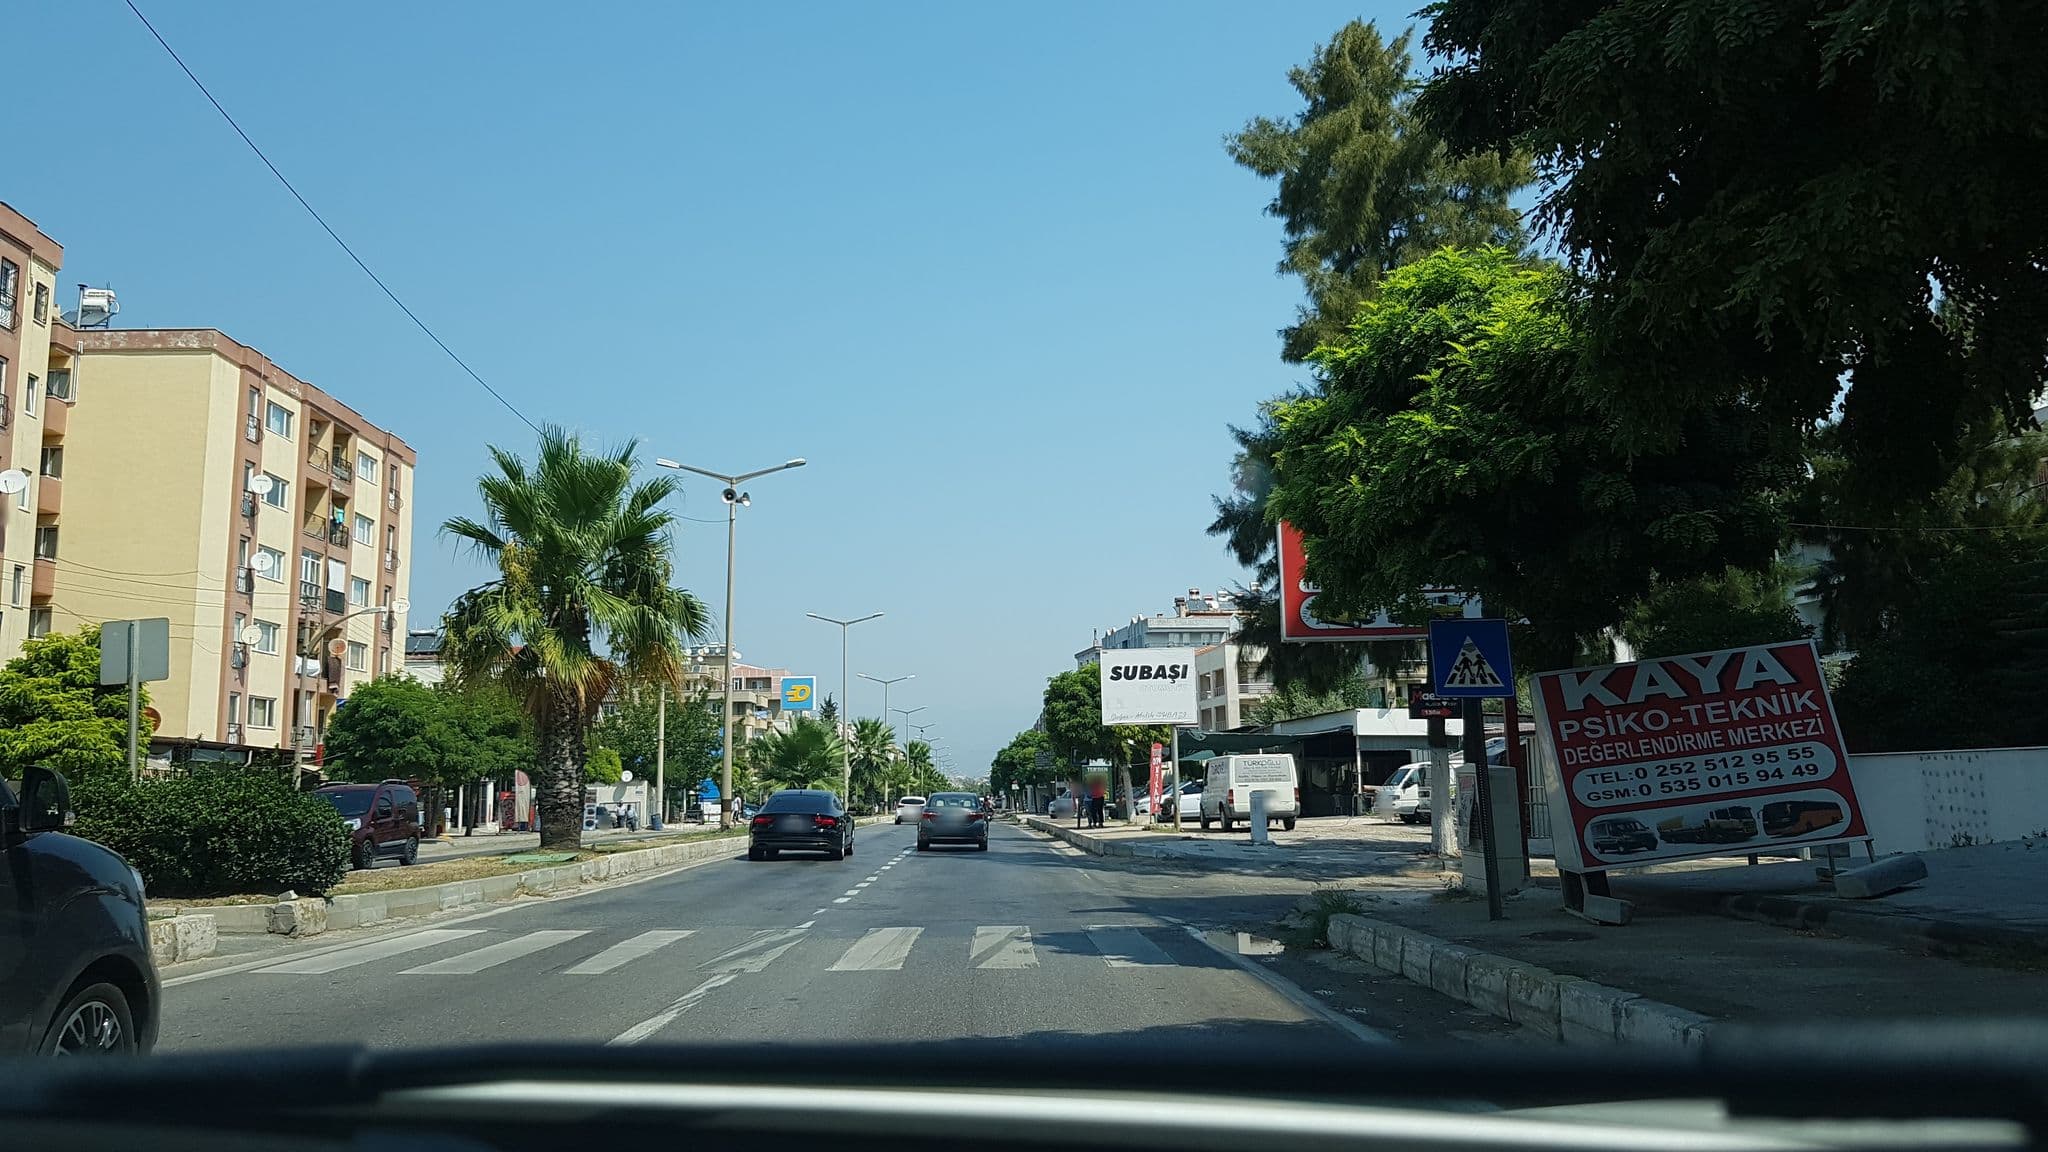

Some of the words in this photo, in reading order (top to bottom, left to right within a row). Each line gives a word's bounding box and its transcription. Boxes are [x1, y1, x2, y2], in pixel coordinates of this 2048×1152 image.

[1109, 664, 1188, 684] SUBAŞI
[1559, 649, 1797, 711] KAYA
[1558, 688, 1820, 741] PSİKO-TEKNİK
[1563, 730, 1725, 765] DEĞERLENDİRME
[1727, 713, 1825, 746] MERKEZİ
[1655, 761, 1697, 777] 252
[1704, 755, 1745, 771] 512
[1751, 751, 1780, 765] 95
[1787, 746, 1815, 760] 55
[1660, 778, 1701, 794] 535
[1707, 772, 1749, 788] 015
[1756, 767, 1784, 781] 94
[1791, 763, 1819, 777] 49
